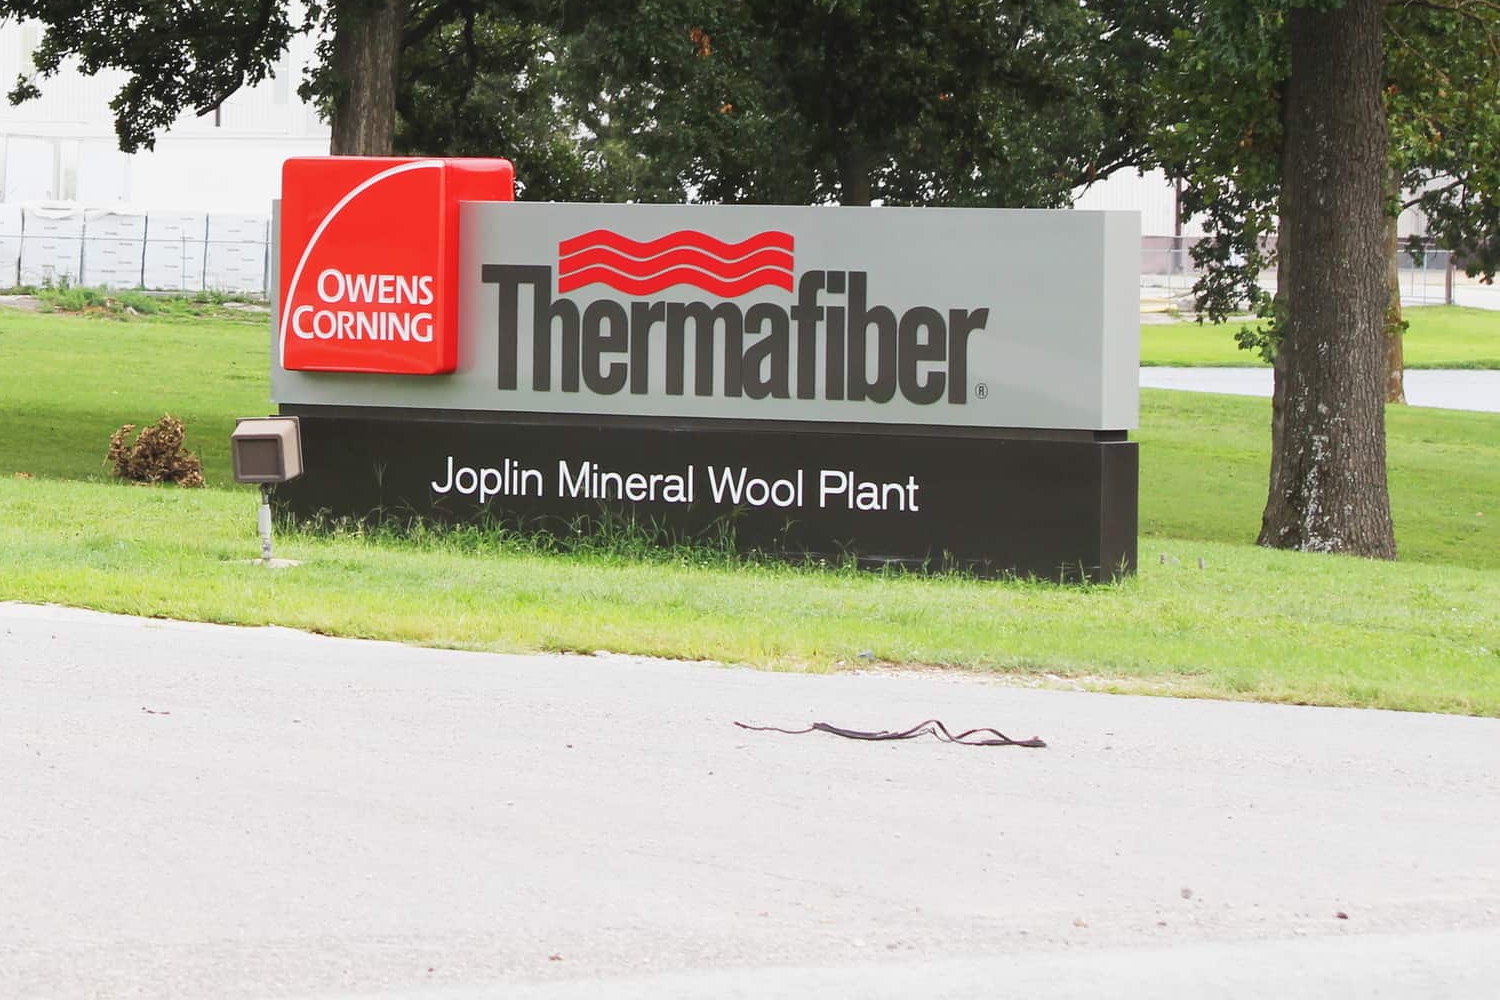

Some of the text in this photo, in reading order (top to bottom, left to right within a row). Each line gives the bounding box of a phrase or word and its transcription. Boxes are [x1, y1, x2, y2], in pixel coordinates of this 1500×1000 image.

[317, 268, 434, 305] OWENS
[292, 305, 433, 342] CORNING
[482, 264, 990, 405] Thermafiber
[431, 456, 919, 512] Joplin Mineral Wool Plant
